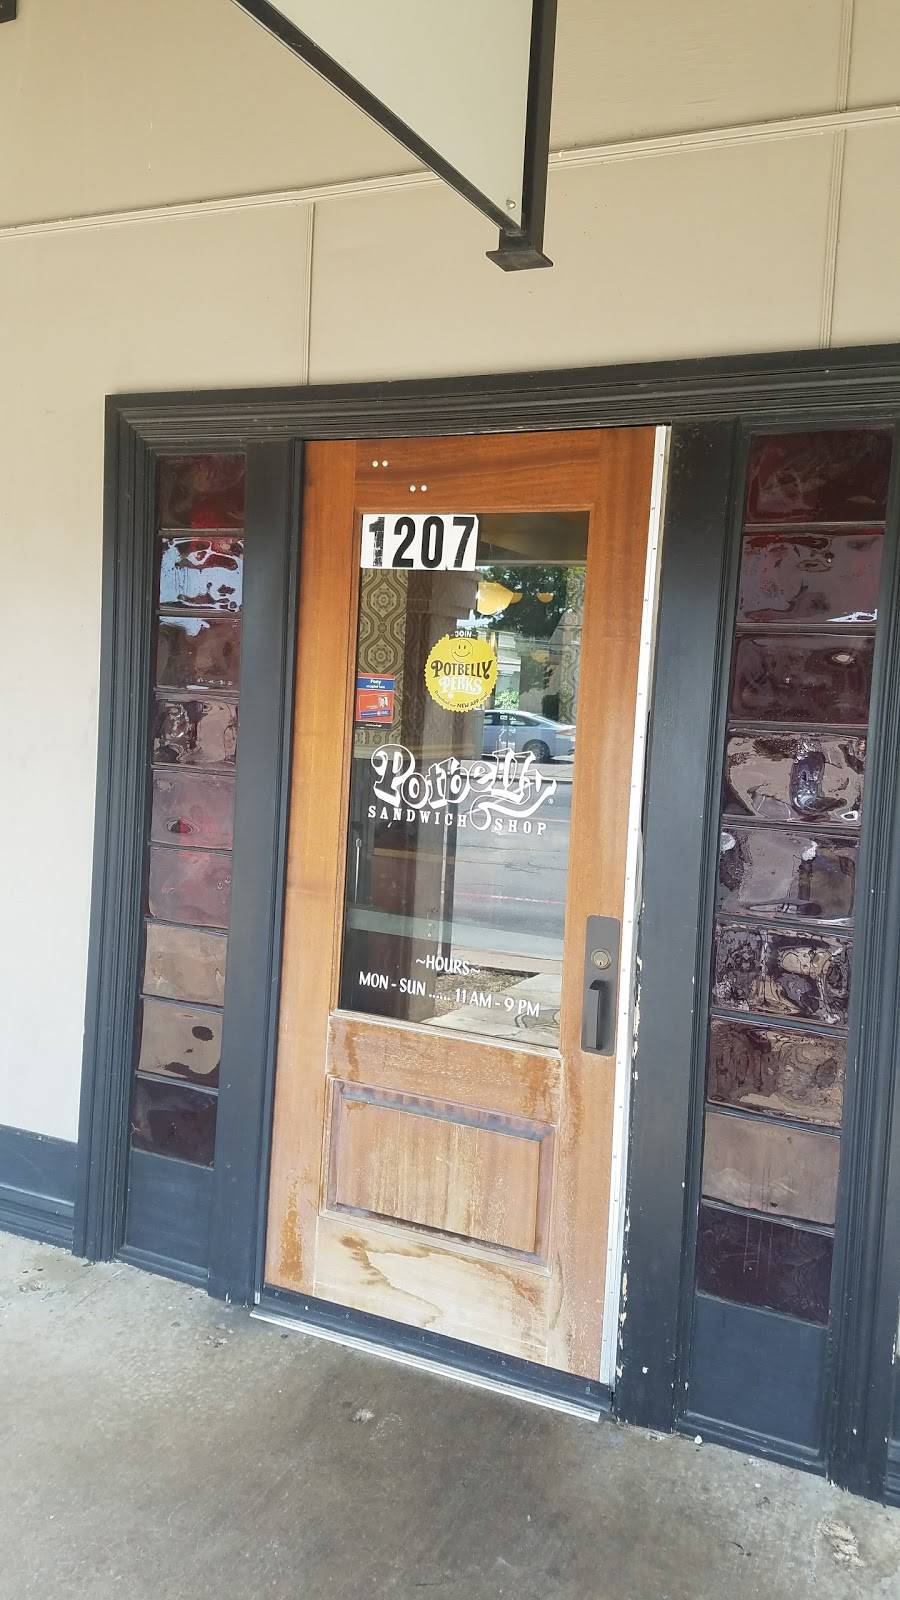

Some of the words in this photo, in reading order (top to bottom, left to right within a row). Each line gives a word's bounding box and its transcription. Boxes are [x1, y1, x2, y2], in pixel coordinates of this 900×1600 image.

[368, 516, 475, 568] 1207
[454, 630, 473, 638] JOIN
[430, 660, 493, 679] POTBELLY
[439, 677, 483, 695] PERKS
[371, 744, 557, 830] Potbelly
[367, 805, 467, 828] SANDWICH
[494, 817, 547, 836] SHOP
[359, 971, 388, 990] MON
[399, 978, 426, 996] SUN
